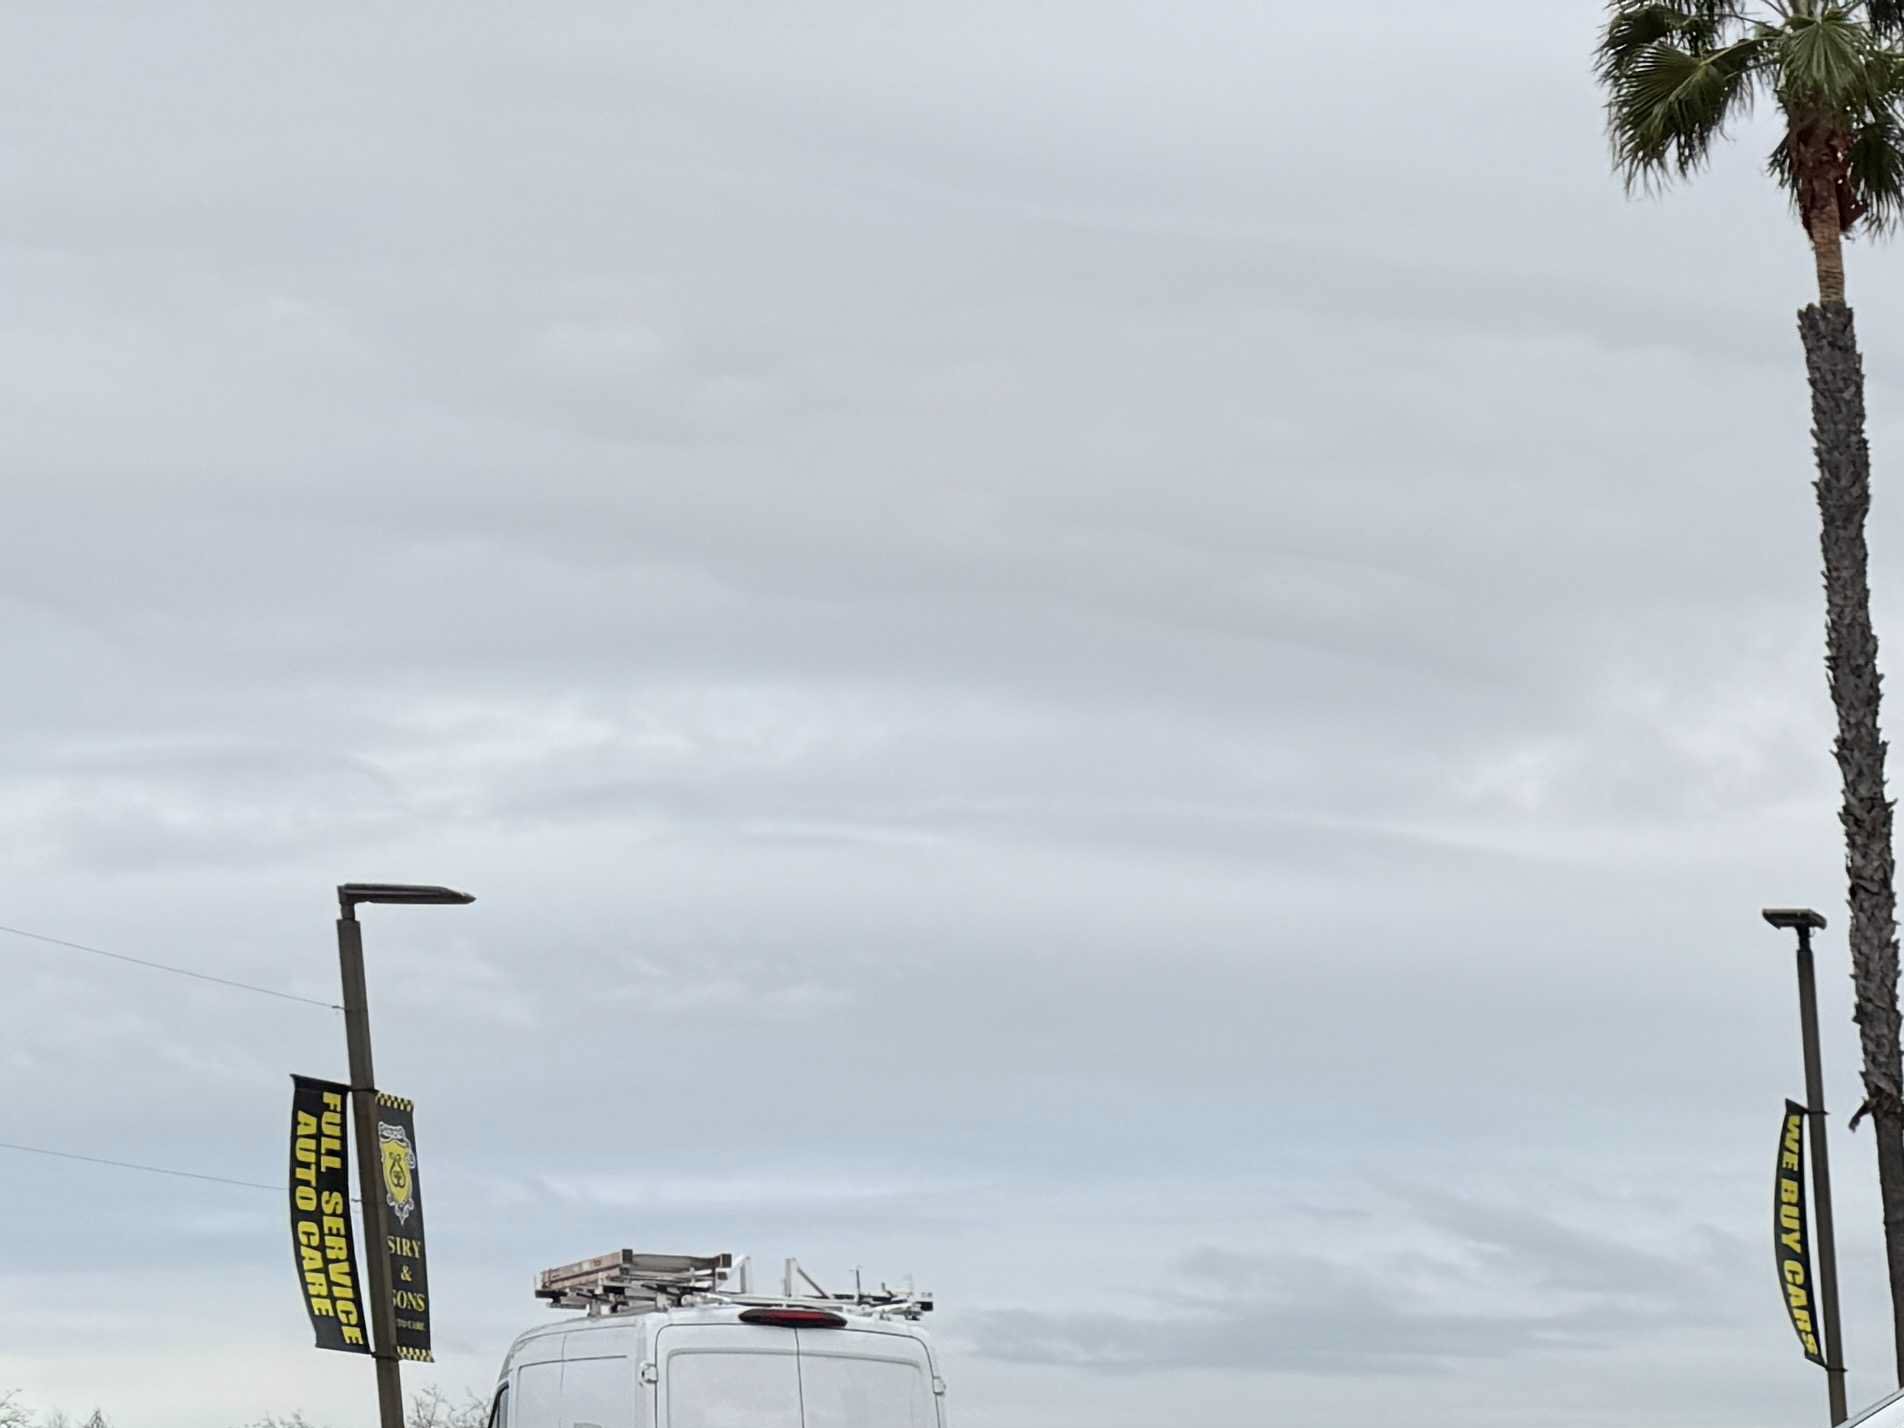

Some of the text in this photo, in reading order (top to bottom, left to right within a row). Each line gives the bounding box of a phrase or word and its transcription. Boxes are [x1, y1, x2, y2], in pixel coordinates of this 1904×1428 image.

[296, 1111, 334, 1317] AUTO CARE
[321, 1092, 363, 1345] FULL SERVICE
[387, 1235, 421, 1259] SIRY
[401, 1264, 412, 1282] &
[1780, 1115, 1818, 1356] WE BUY CARS
